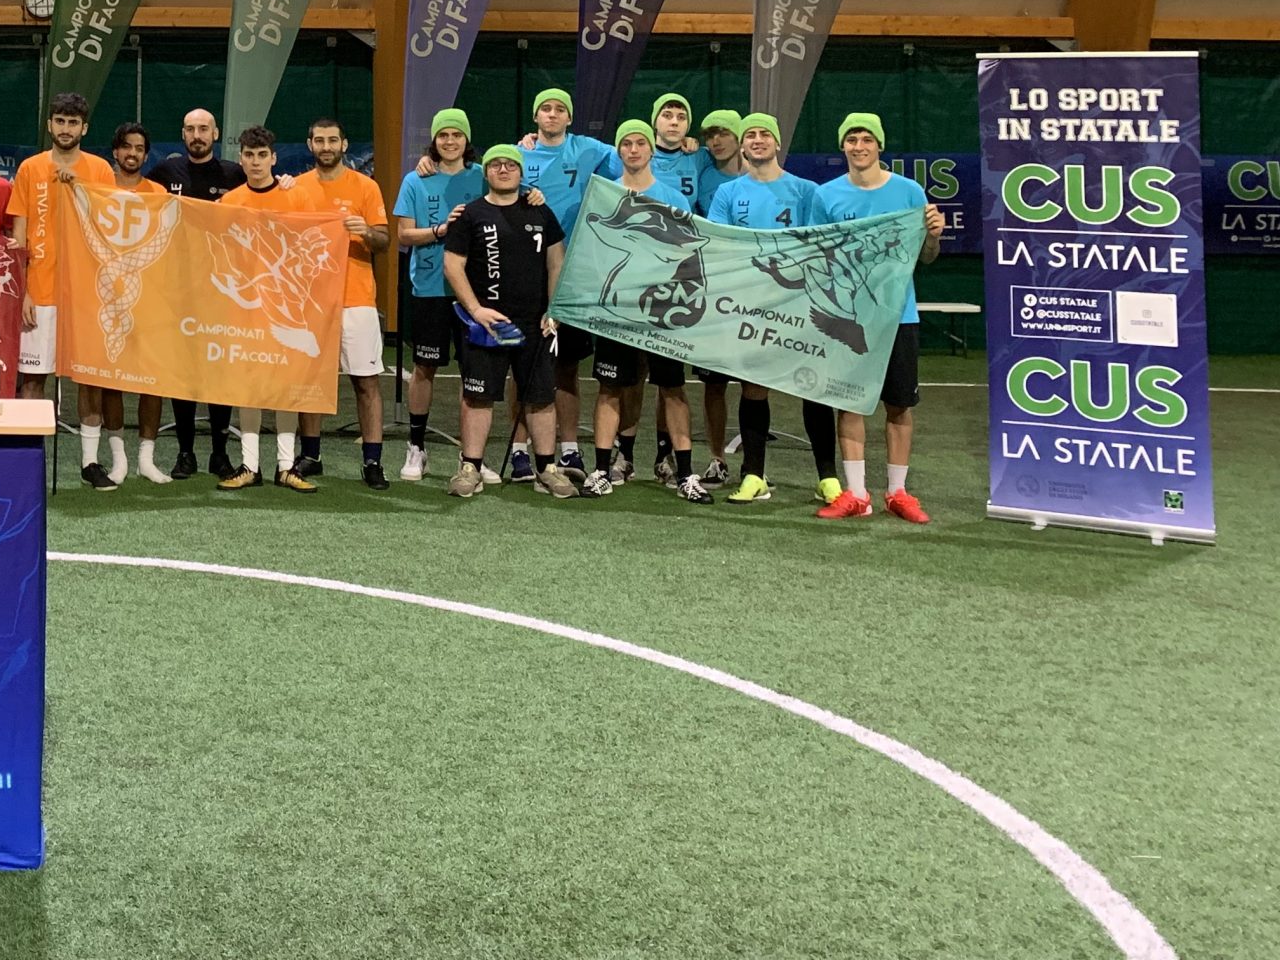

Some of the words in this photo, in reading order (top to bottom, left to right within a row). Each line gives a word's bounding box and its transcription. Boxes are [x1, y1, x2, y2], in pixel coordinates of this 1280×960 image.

[1009, 88, 1048, 112] LO
[1058, 88, 1164, 113] SPORT
[997, 117, 1031, 141] IN
[1040, 118, 1181, 143] STATALE
[563, 169, 578, 188] 7
[680, 177, 695, 196] 5
[1001, 162, 1182, 228] CUS
[36, 181, 49, 237] STATALE
[98, 197, 146, 240] SF
[775, 207, 793, 227] 4
[35, 240, 45, 259] LA
[483, 223, 500, 280] STATALE
[532, 232, 543, 253] 1
[997, 239, 1035, 268] LA
[1047, 241, 1190, 275] STATALE
[487, 283, 500, 301] LA
[1038, 296, 1058, 306] CUS
[1059, 297, 1098, 308] STATALE
[715, 296, 805, 329] CAMPIONATI
[1035, 309, 1102, 322] @CUSSTATALE
[180, 317, 265, 340] CAMPIONATI
[644, 339, 689, 360] CULTURALE
[646, 329, 696, 352] MEDIAZIONE
[115, 369, 157, 385] FARMACO
[1006, 356, 1189, 428] CUS
[1001, 432, 1041, 461] LA
[1053, 437, 1197, 476] STATALE
